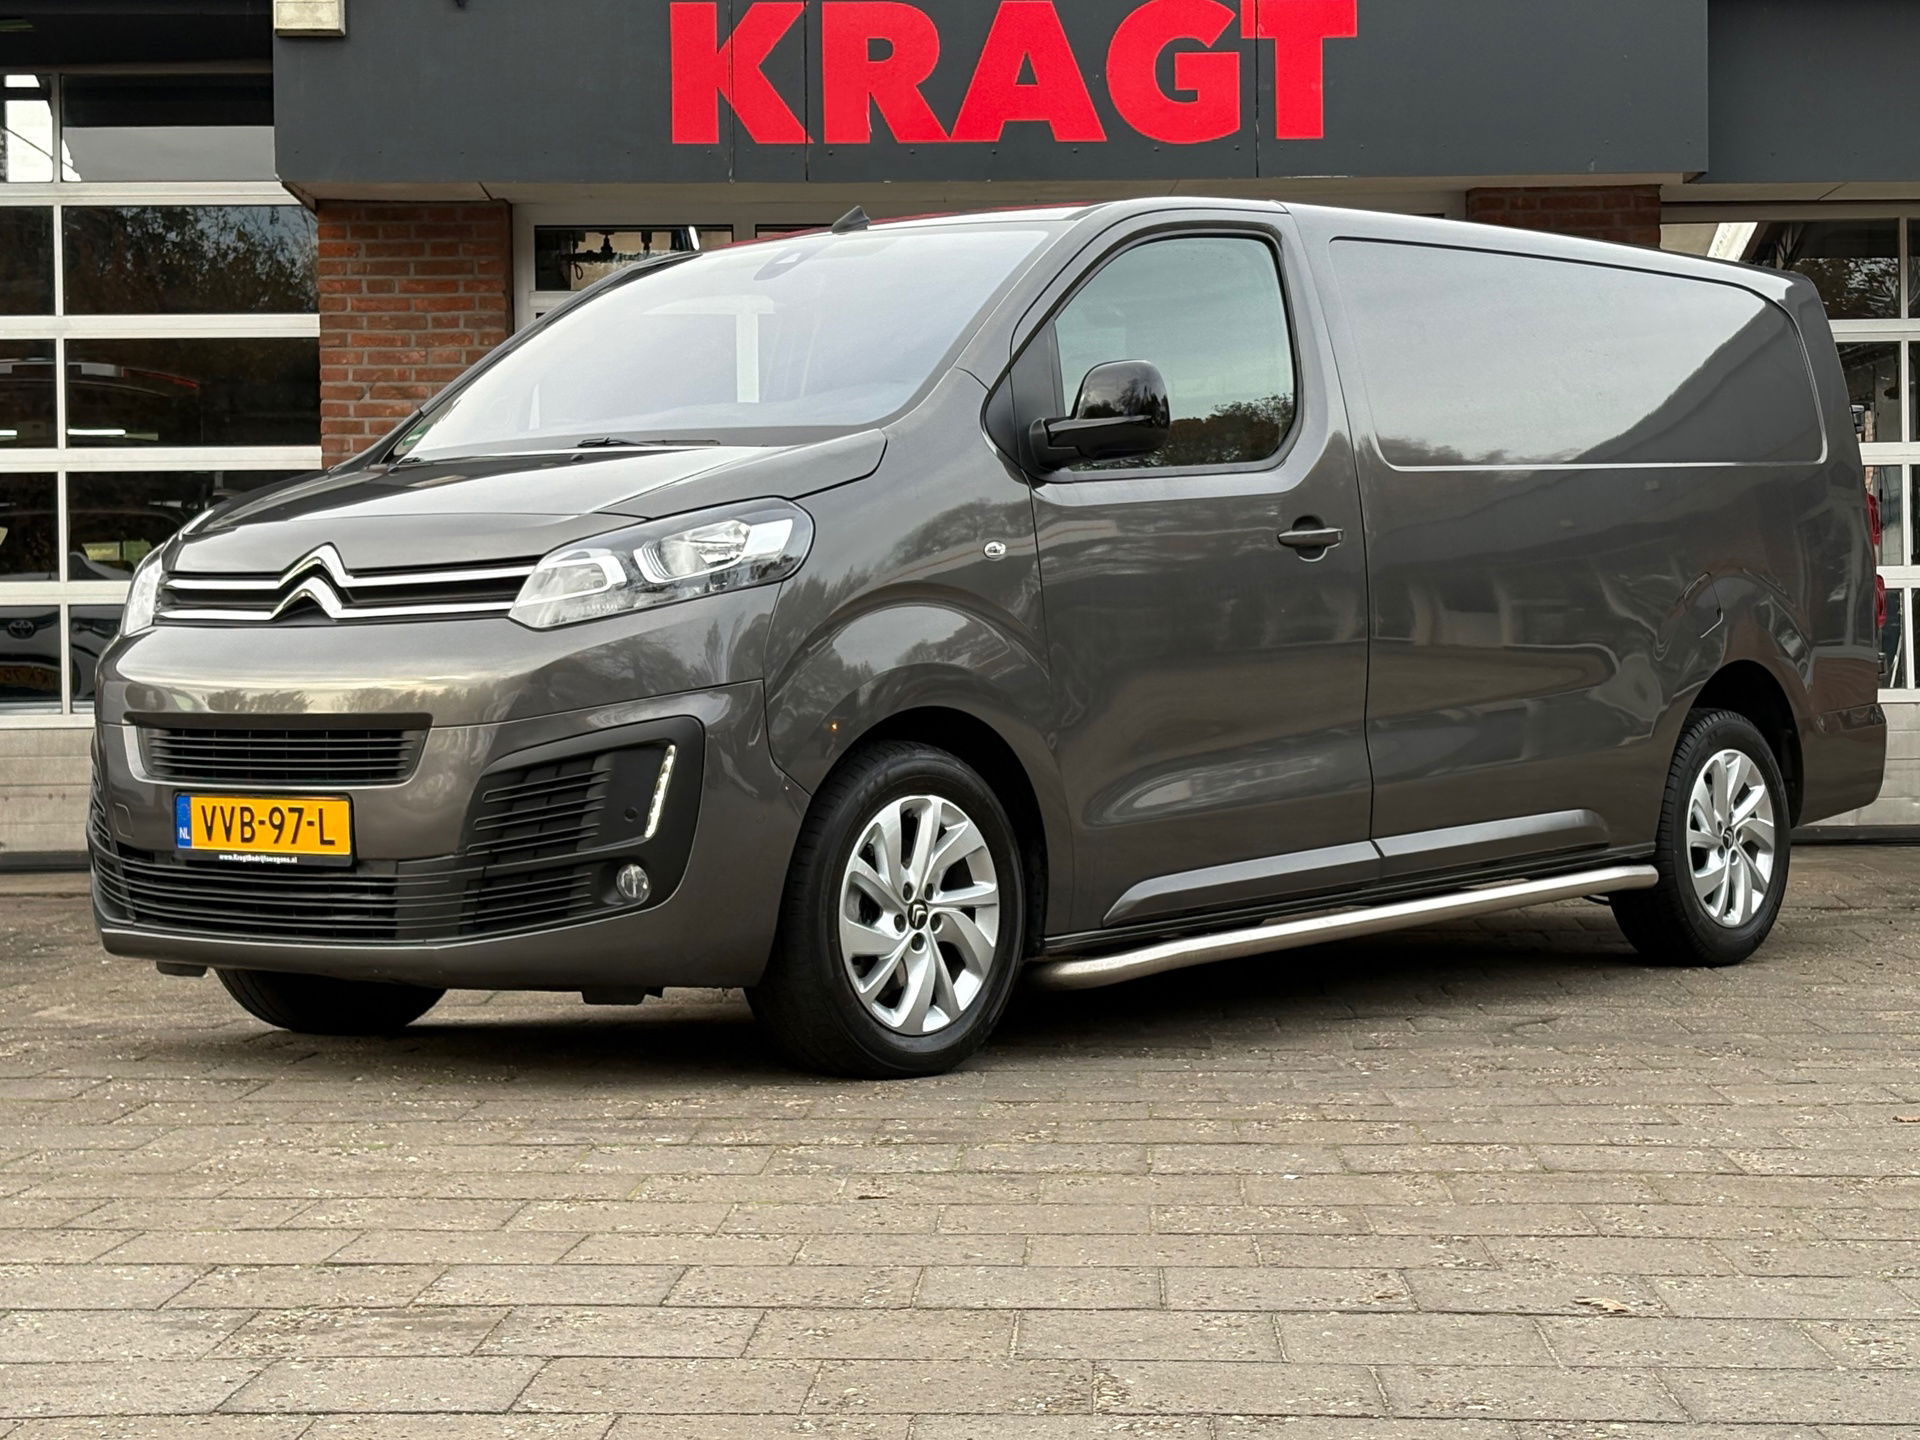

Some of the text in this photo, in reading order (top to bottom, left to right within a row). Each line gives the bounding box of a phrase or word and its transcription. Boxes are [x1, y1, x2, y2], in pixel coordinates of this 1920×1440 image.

[670, 0, 1358, 145] KRAGT
[179, 827, 191, 840] NL
[201, 804, 336, 847] VVB-97-L
